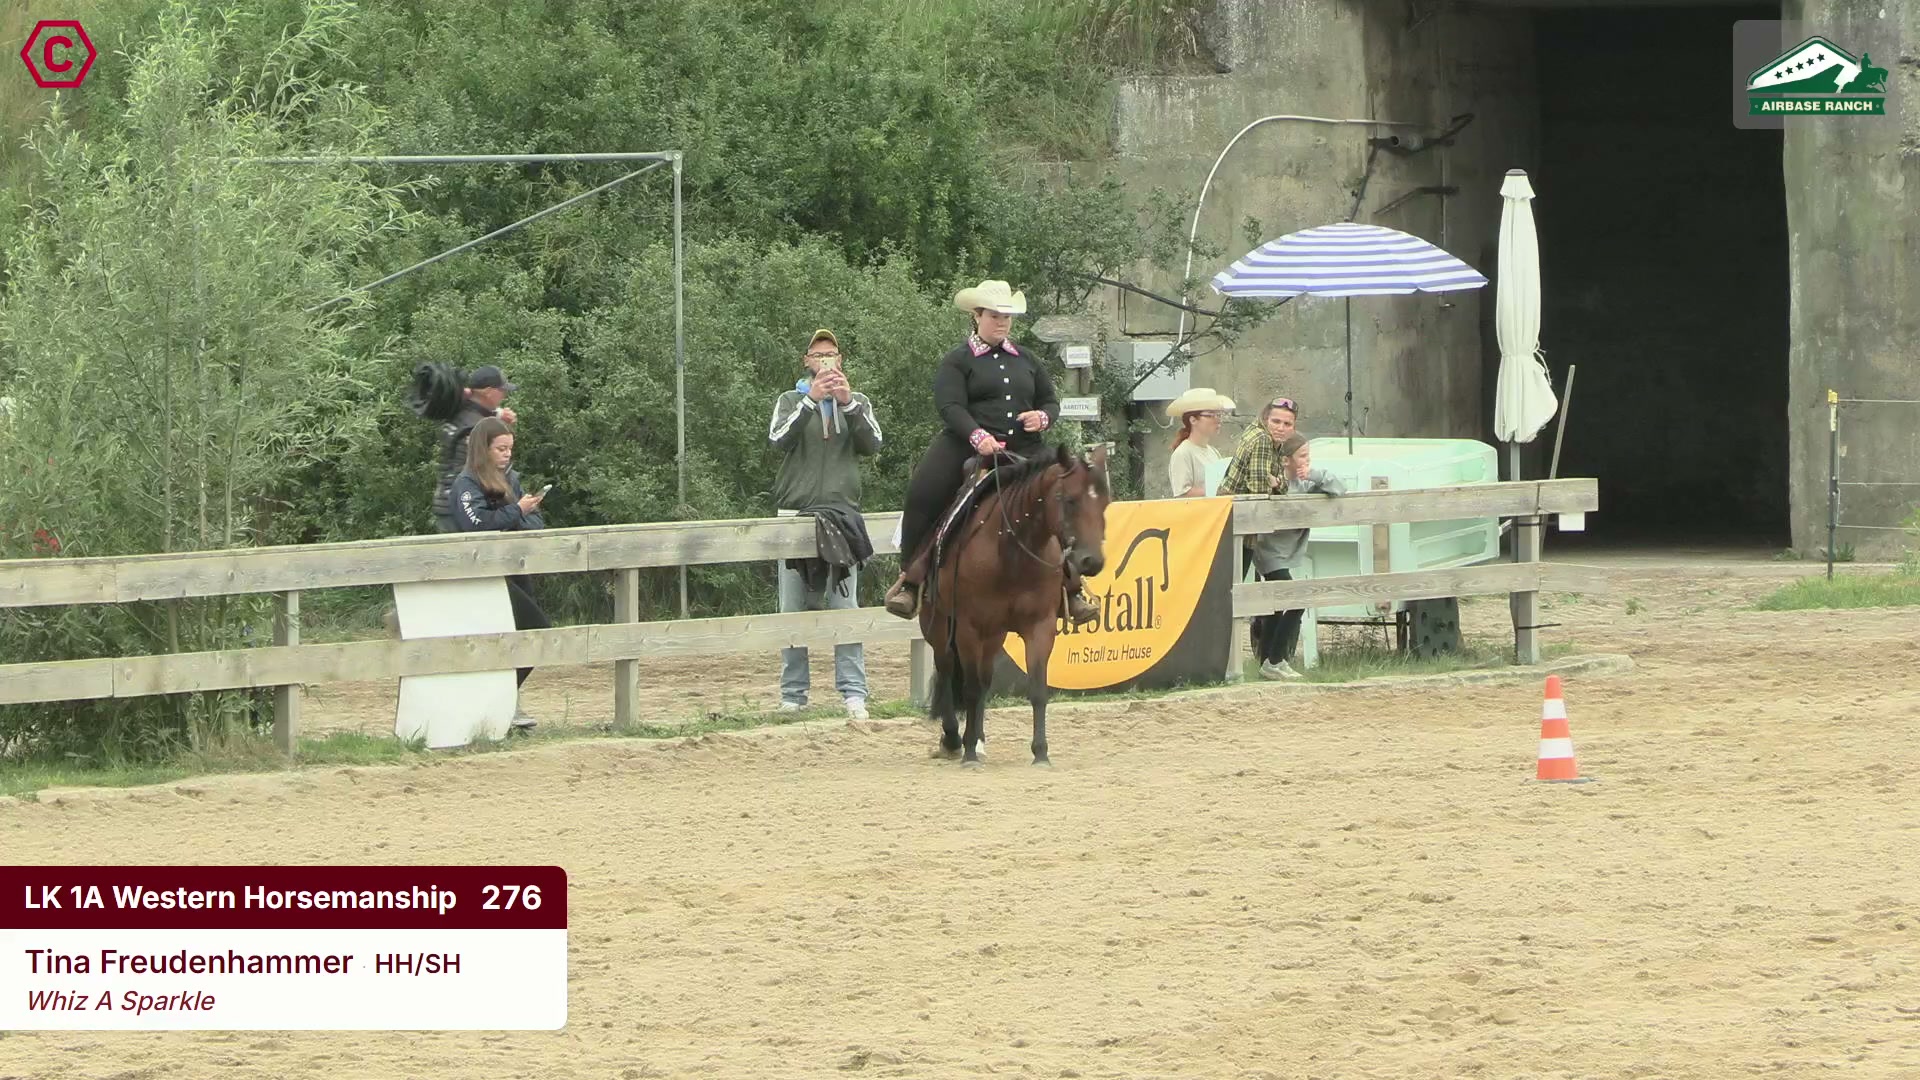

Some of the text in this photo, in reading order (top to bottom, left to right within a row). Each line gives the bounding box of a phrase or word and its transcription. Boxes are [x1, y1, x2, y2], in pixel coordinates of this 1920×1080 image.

[462, 501, 482, 525] ARIAT
[1067, 643, 1152, 664] Im Stall zu Hause
